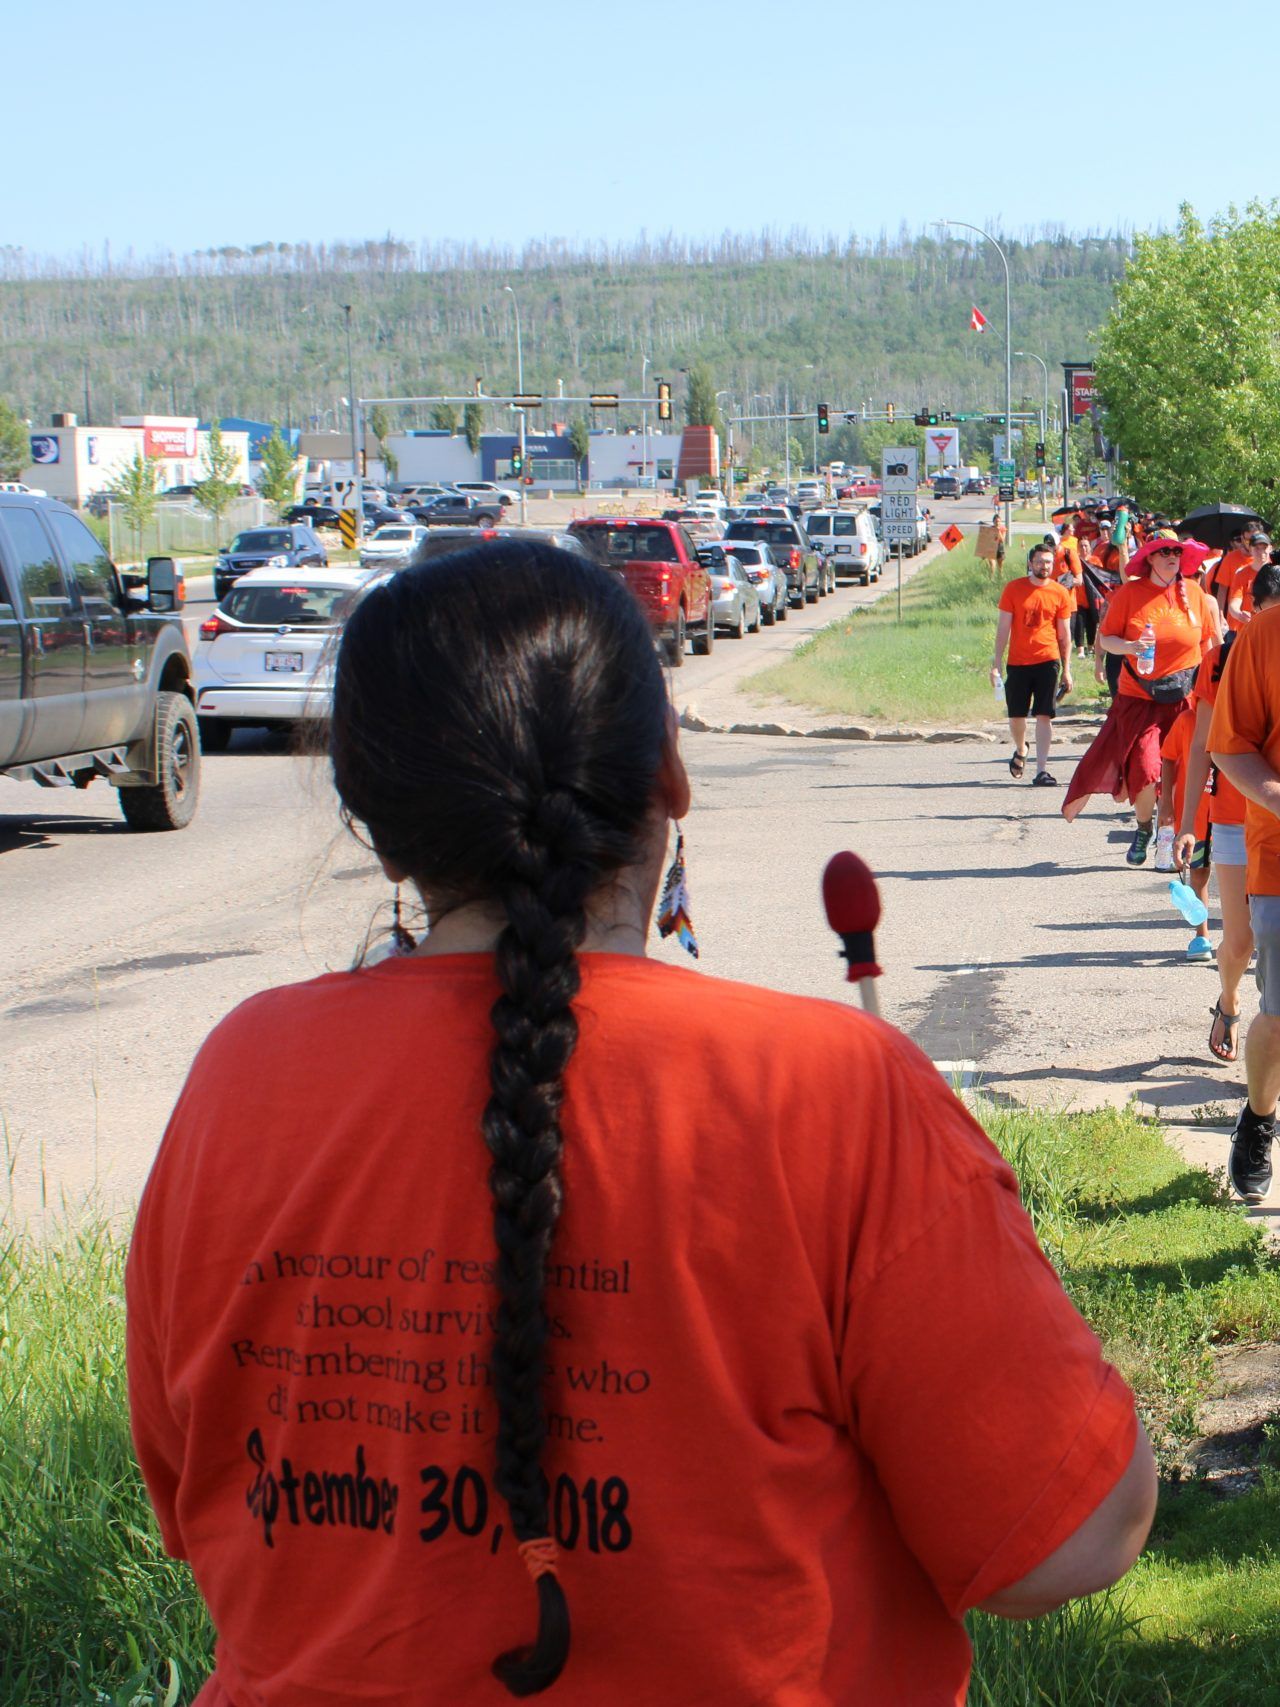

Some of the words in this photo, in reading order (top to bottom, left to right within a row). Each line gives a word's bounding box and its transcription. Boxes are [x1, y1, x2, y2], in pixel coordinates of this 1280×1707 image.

[1074, 387, 1104, 396] STAPL
[885, 508, 914, 518] LIGHT
[890, 496, 910, 507] RED
[887, 525, 913, 534] SPEED
[397, 1249, 436, 1282] of
[444, 1259, 630, 1293] resntial
[400, 1304, 572, 1339] survivs.
[566, 1360, 650, 1394] who
[296, 1395, 359, 1424] not
[366, 1401, 451, 1434] make
[460, 1403, 484, 1434] it
[547, 1412, 604, 1443] me.
[246, 1428, 399, 1549] Sptember
[419, 1465, 504, 1554] 30,
[553, 1472, 632, 1553] 018
